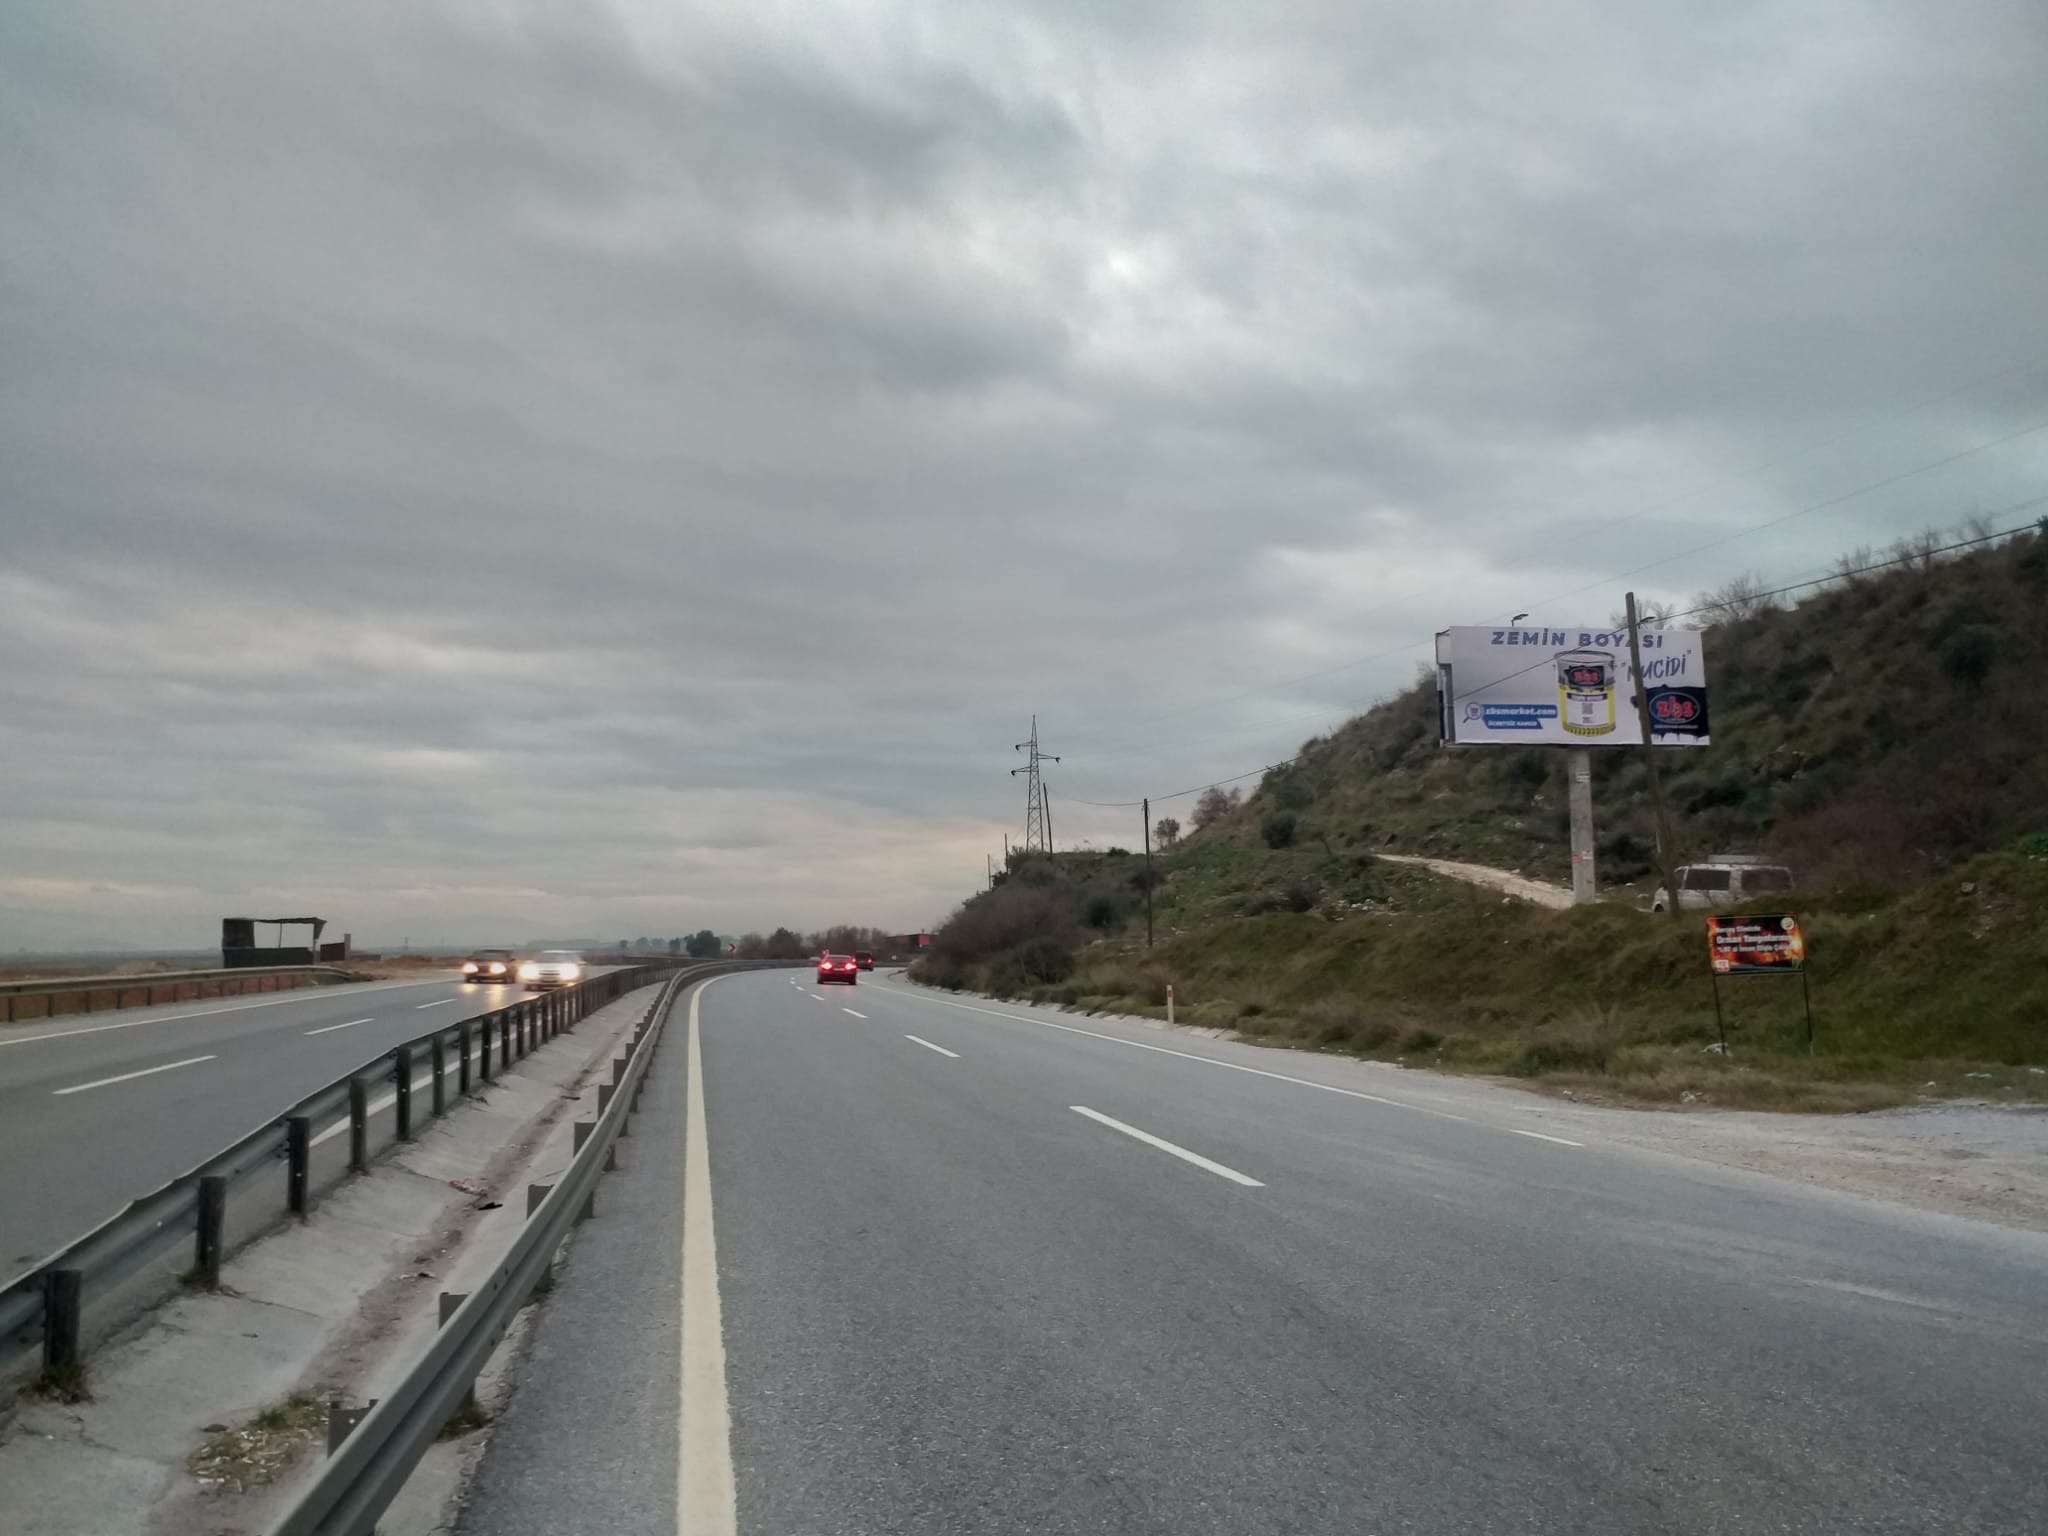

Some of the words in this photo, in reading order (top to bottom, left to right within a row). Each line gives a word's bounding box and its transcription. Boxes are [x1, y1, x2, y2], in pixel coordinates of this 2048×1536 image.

[1491, 628, 1566, 646] ZEMİN
[1578, 632, 1663, 649] BOYSI
[1656, 695, 1695, 718] zbs
